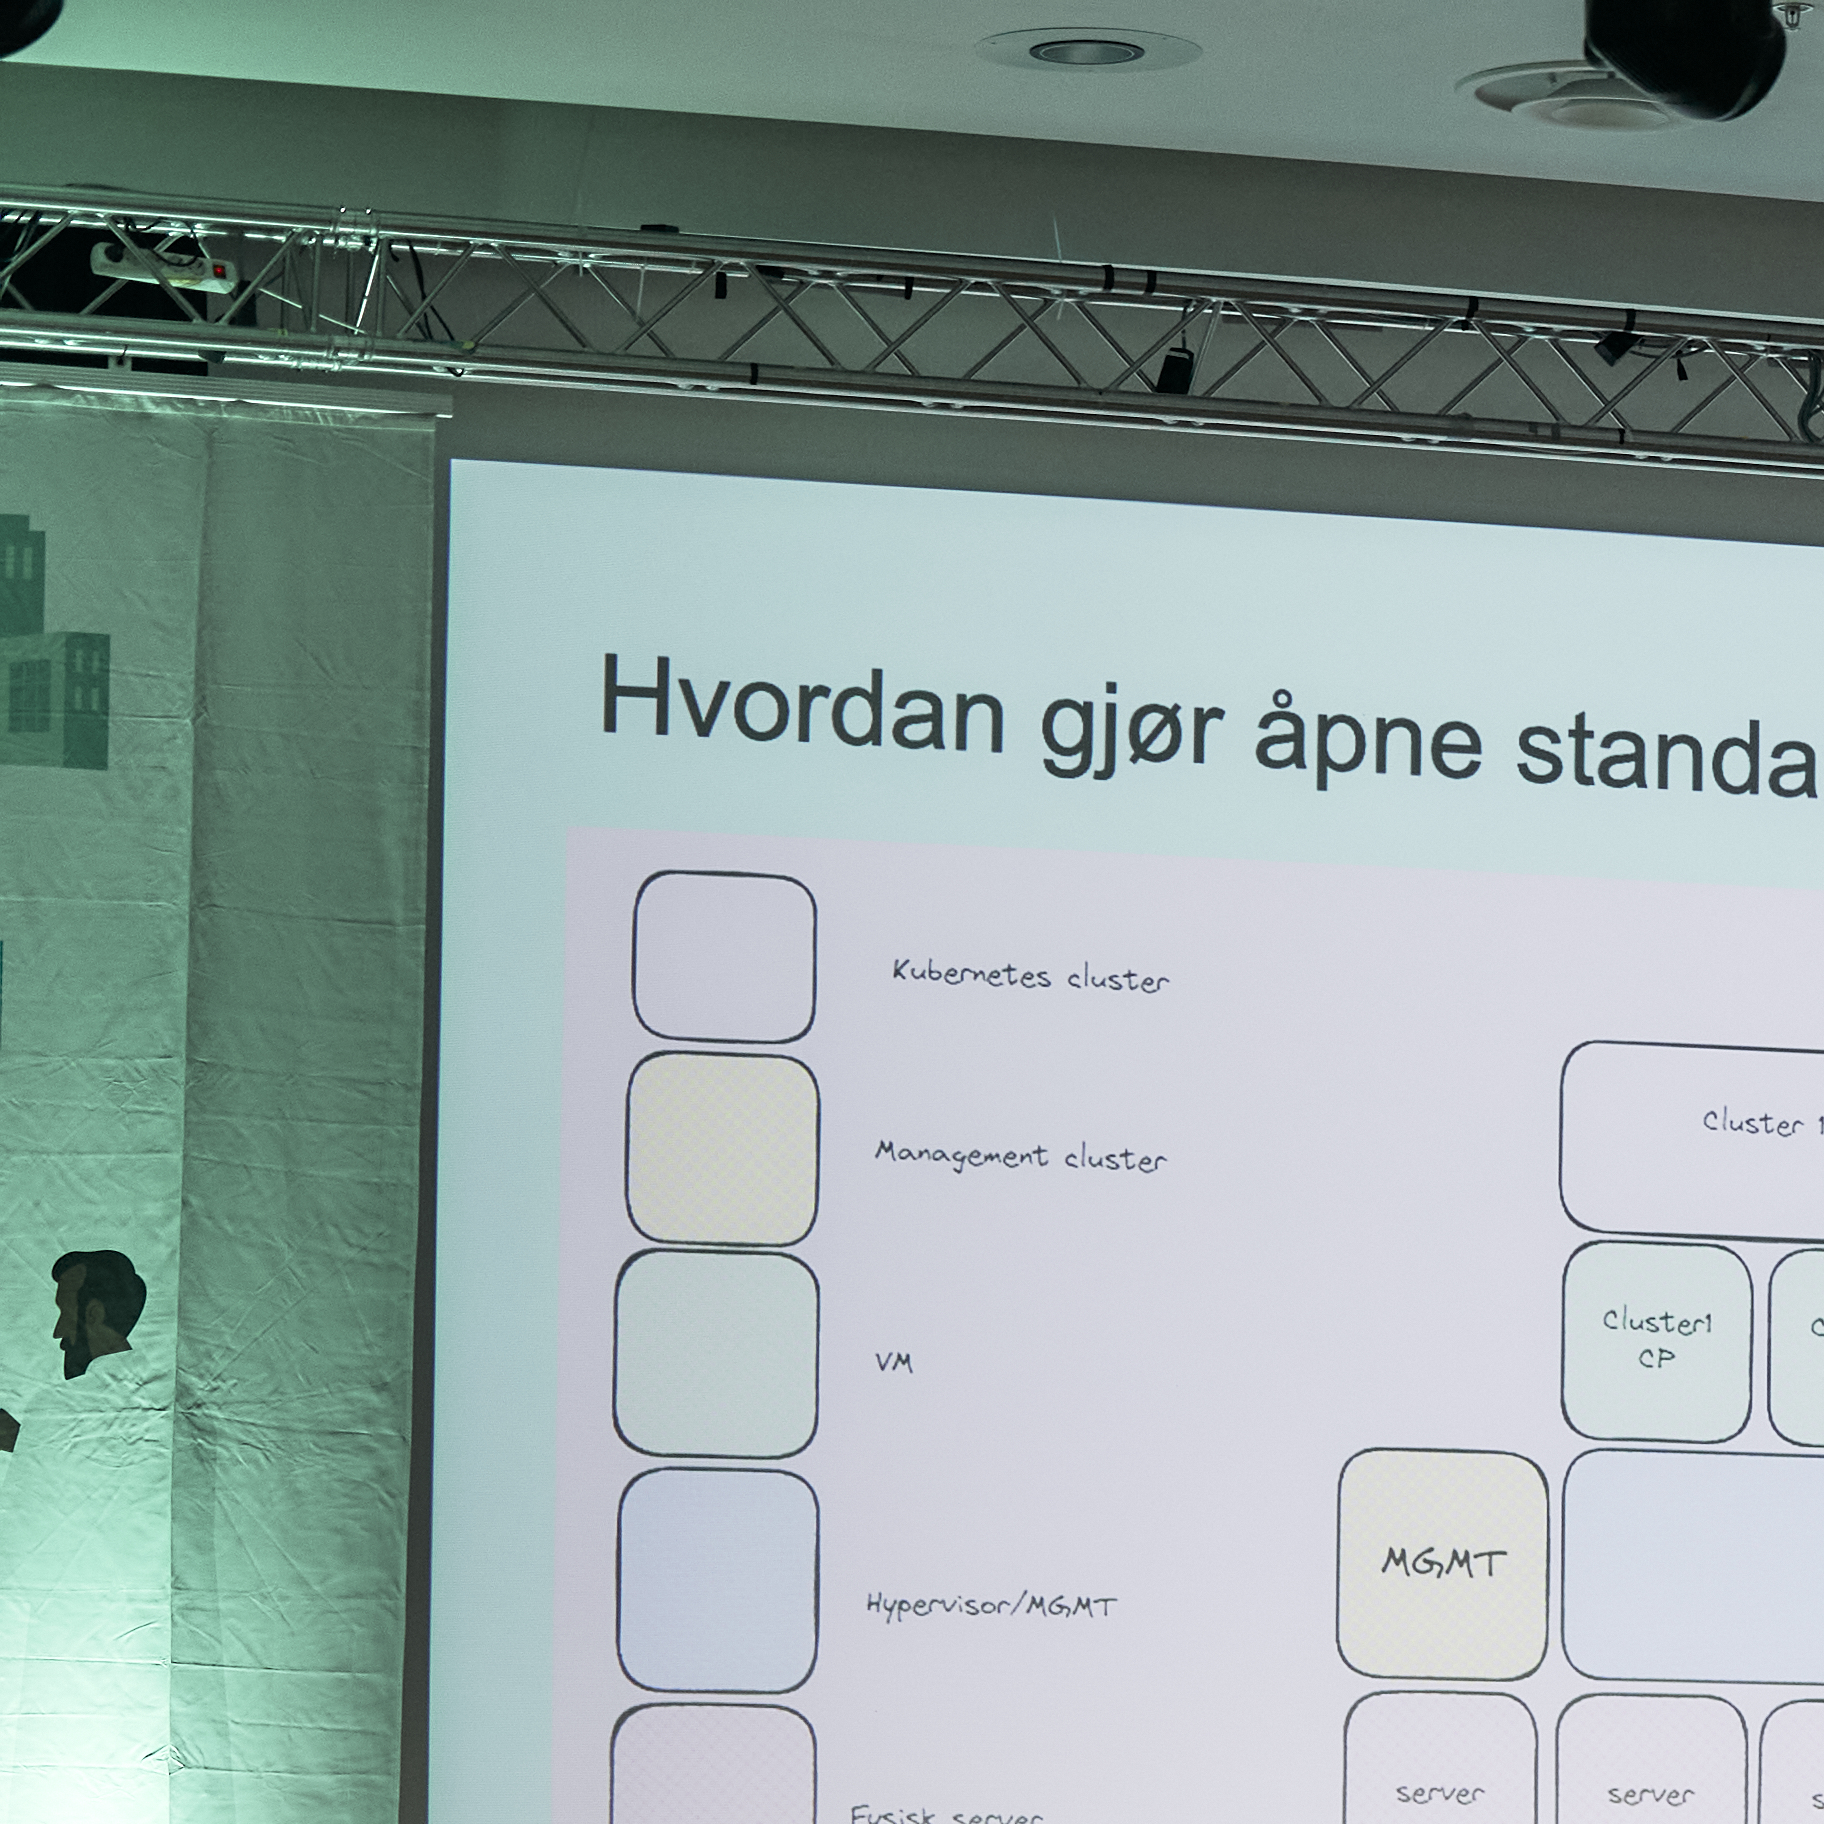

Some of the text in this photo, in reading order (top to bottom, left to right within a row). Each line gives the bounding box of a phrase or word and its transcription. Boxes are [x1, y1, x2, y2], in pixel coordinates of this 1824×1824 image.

[602, 651, 1005, 755] Hvordan
[1040, 680, 1227, 782] gjør
[1254, 687, 1484, 793] åpne
[891, 957, 1171, 995] Kubernetes cluster
[1702, 1104, 1806, 1139] Cluster
[873, 1138, 1169, 1176] Management cluster
[1602, 1303, 1713, 1338] Cluster1
[874, 1350, 915, 1375] VM
[1637, 1346, 1677, 1370] CP
[1380, 1545, 1509, 1580] MGMT
[865, 1588, 1119, 1626] Hypervisor/MGMT
[1395, 1784, 1487, 1807] server
[1606, 1786, 1697, 1808] server
